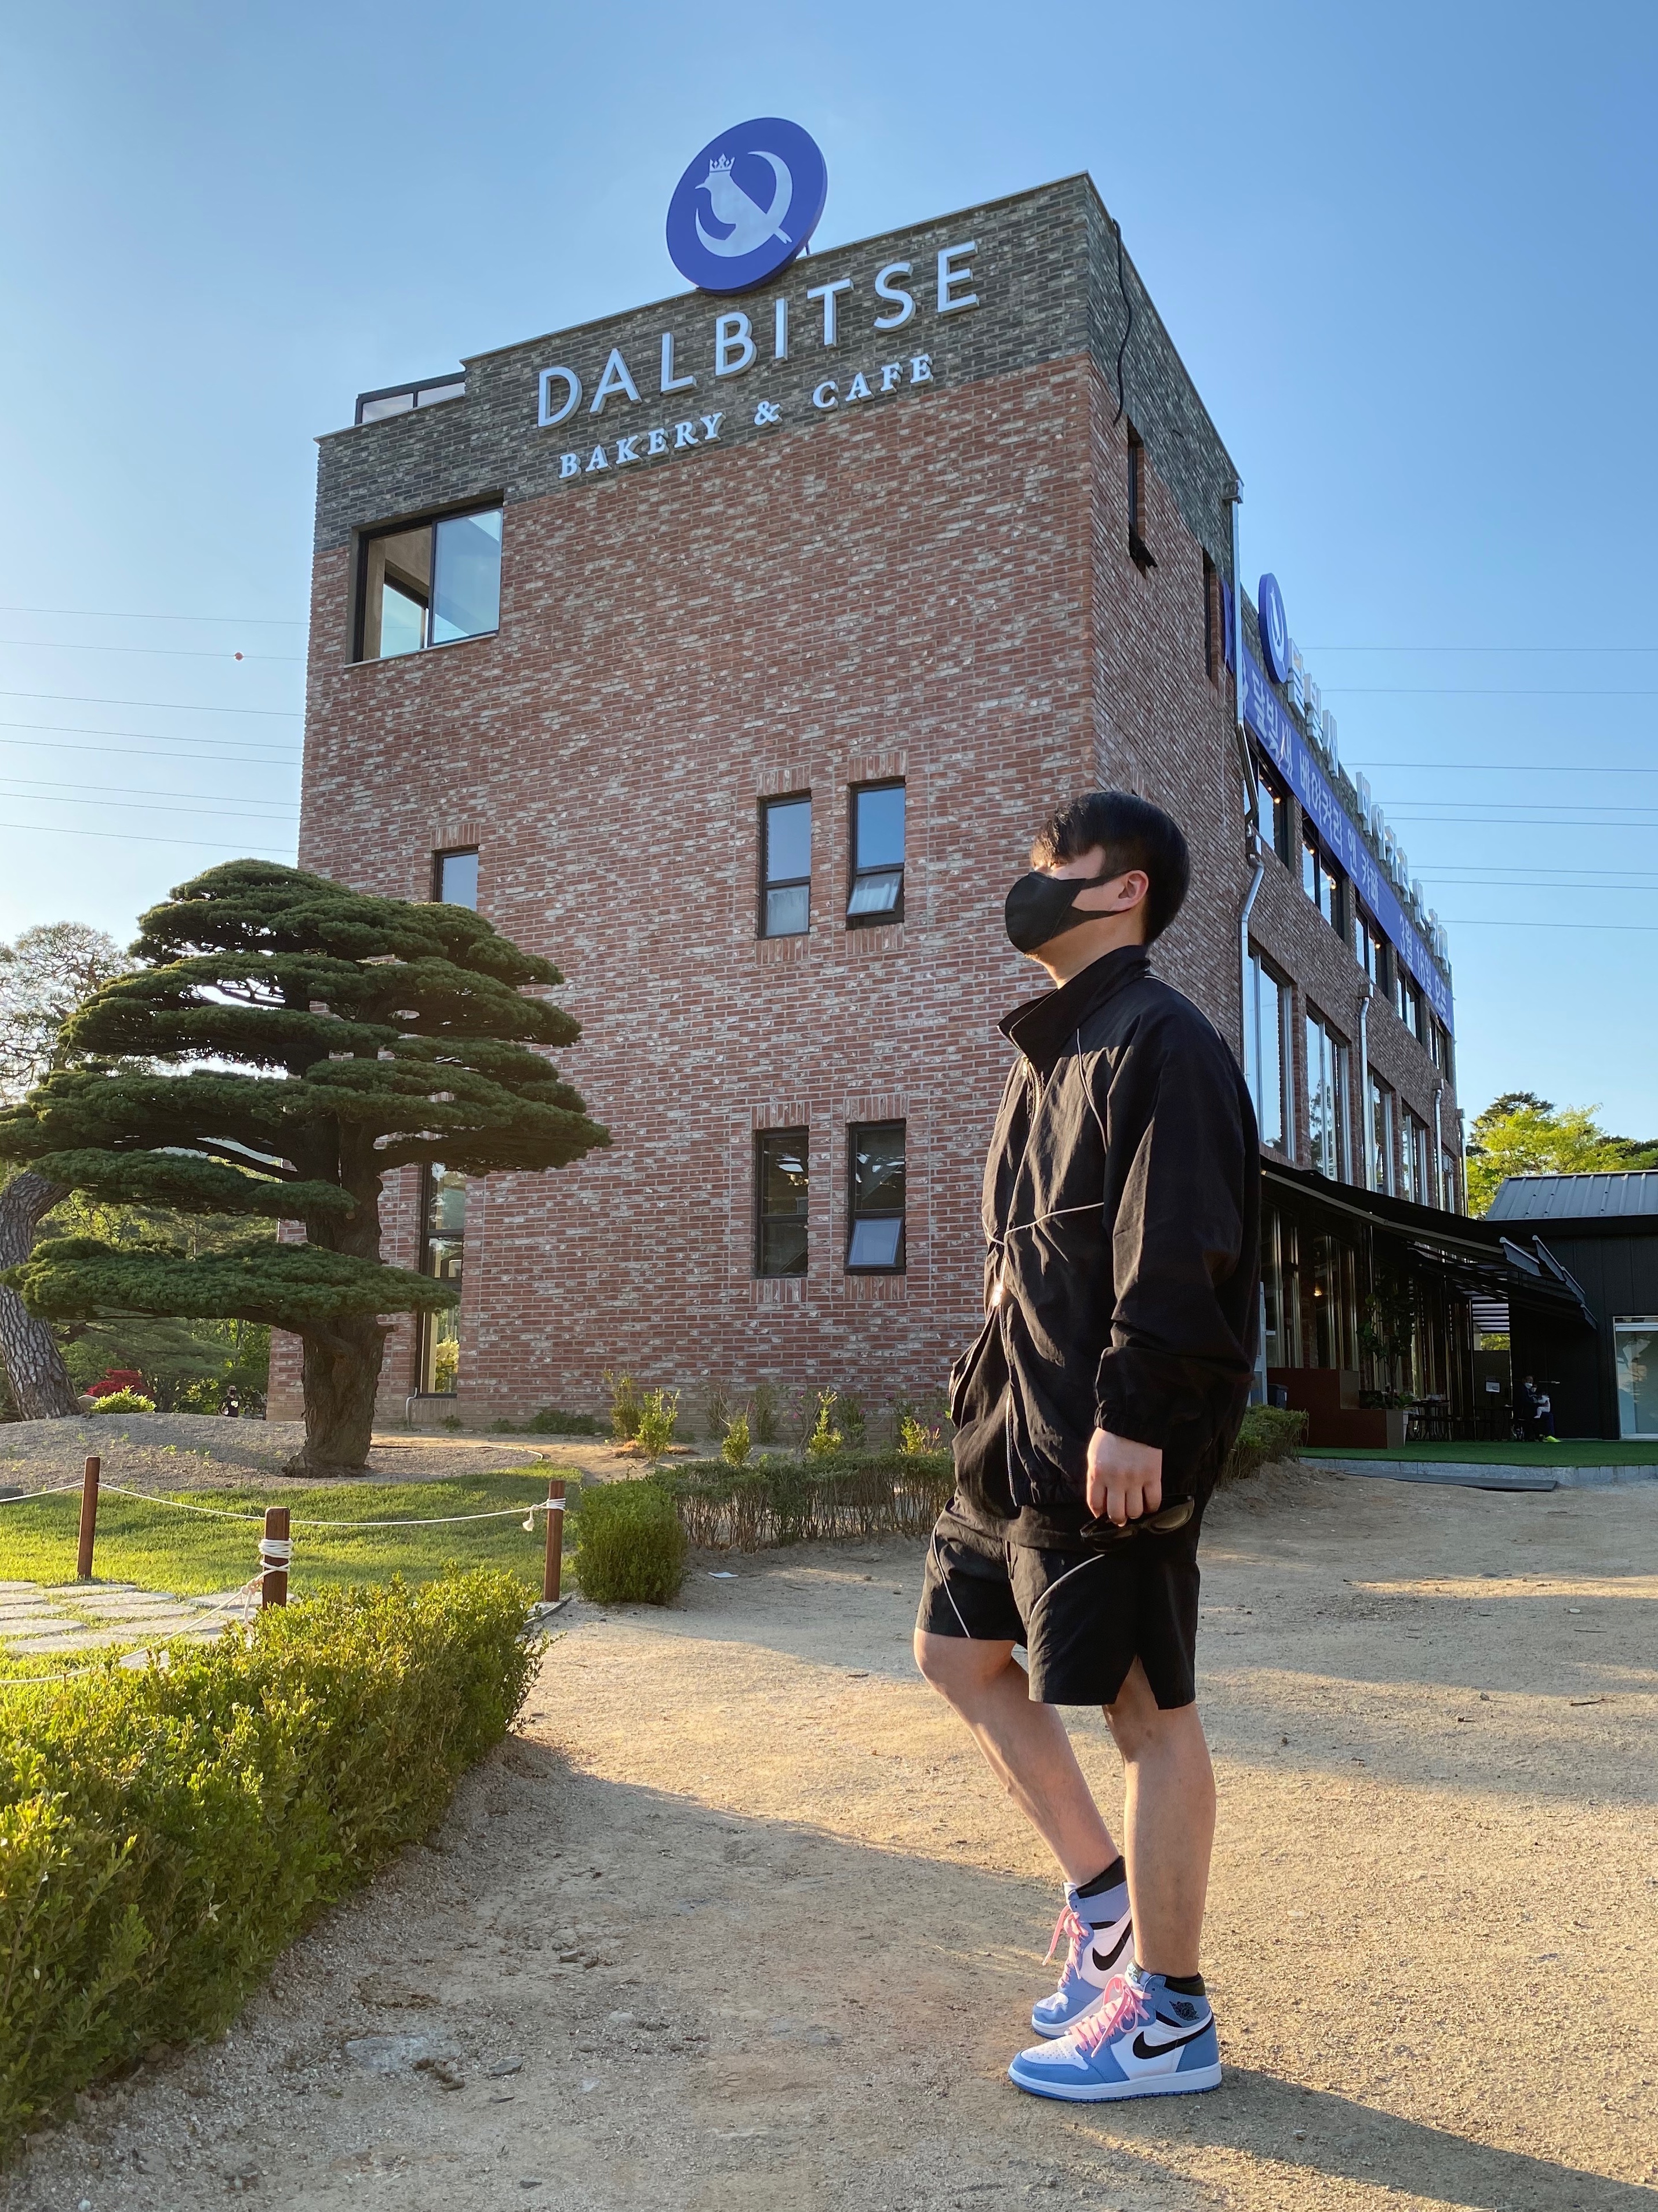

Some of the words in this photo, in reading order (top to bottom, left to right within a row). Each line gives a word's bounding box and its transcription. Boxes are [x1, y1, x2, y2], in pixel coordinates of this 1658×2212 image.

[538, 241, 980, 428] DALBITSE
[558, 412, 725, 481] BAKERY
[754, 400, 783, 431] &
[812, 353, 934, 412] CAFE
[1252, 669, 1293, 782] 달빛새
[1299, 748, 1343, 859] 베이커리
[1361, 852, 1379, 915] 카페
[1399, 913, 1414, 972] 3월
[1416, 942, 1432, 1001] 16일
